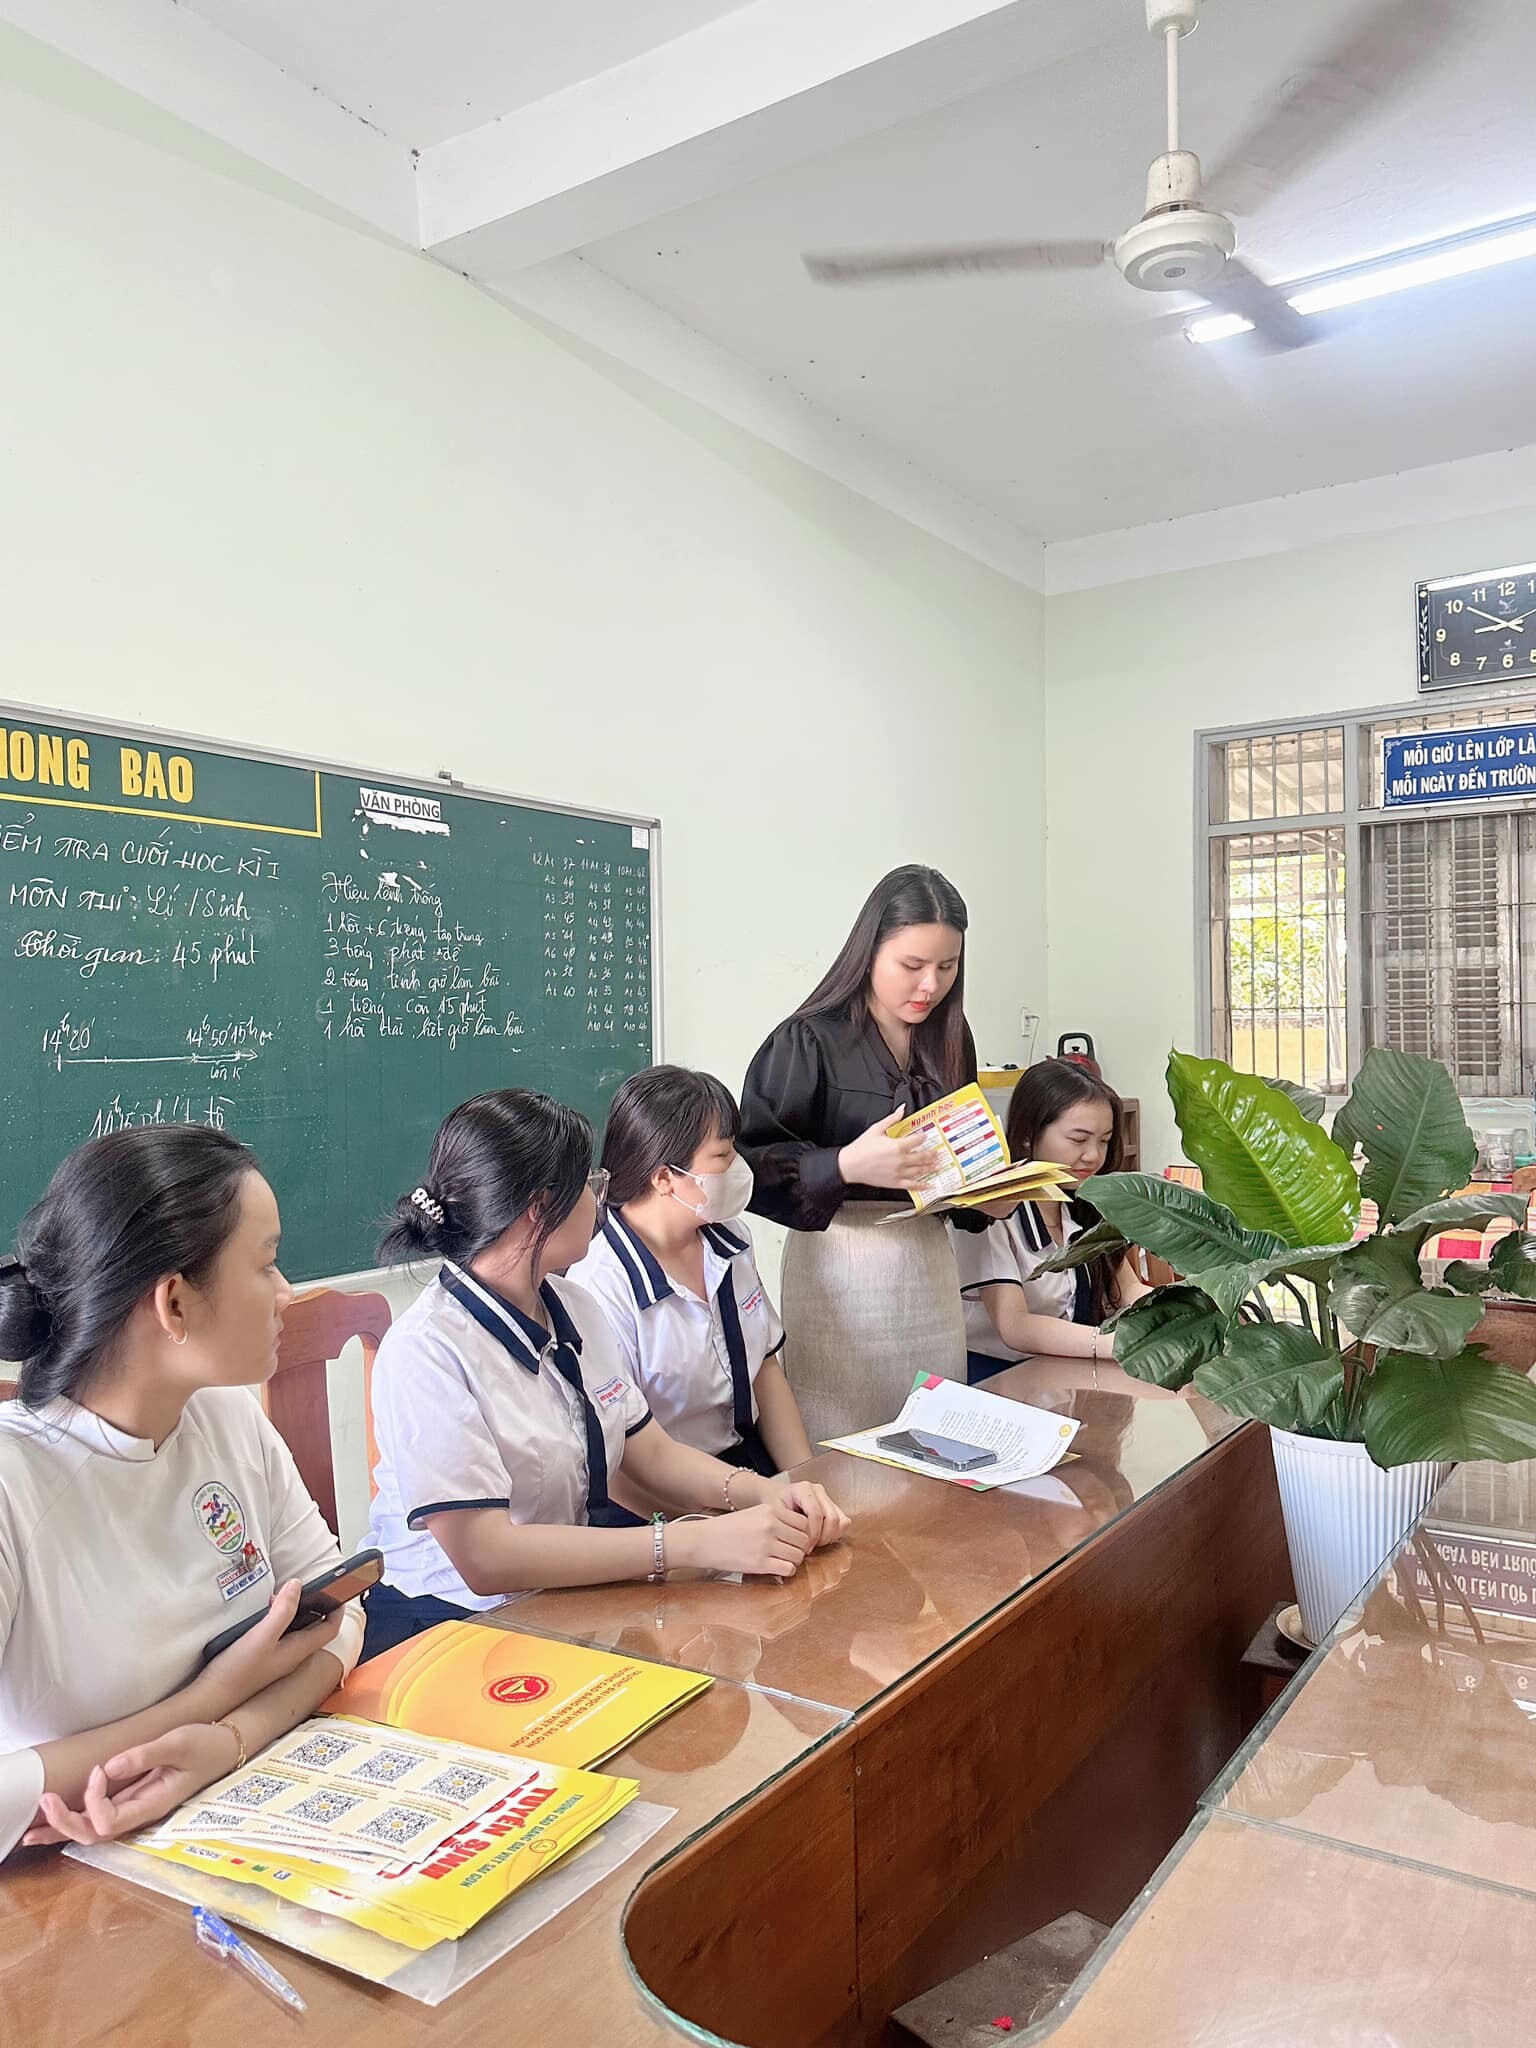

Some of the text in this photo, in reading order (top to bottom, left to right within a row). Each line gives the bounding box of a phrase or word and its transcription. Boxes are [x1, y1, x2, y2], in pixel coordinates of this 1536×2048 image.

[1445, 600, 1463, 614] 10
[1472, 588, 1486, 602] 11
[1497, 581, 1516, 596] 12
[1436, 628, 1446, 642] 9
[1450, 652, 1460, 666] 8
[1476, 656, 1487, 670] 7
[1503, 654, 1513, 668] 6
[0, 727, 194, 804] ONG BAO
[1403, 732, 1536, 767] MỖI GIỜ LÊN LỚP LÀ
[1392, 771, 1416, 797] MỖI
[1421, 771, 1455, 794] NGÀY
[1459, 765, 1486, 790] ĐẾN
[361, 790, 440, 818] VĂN PHÒNG
[0, 812, 42, 854] ỂM
[53, 836, 109, 862] TRA
[9, 877, 69, 909] MÔN
[202, 887, 251, 921] Sinh
[322, 872, 370, 903] Hiệu
[409, 883, 443, 918] trống
[323, 913, 334, 932] 1
[171, 940, 201, 969] 45
[210, 928, 260, 983] phút
[324, 938, 340, 956] 3
[341, 937, 372, 970] tiếng
[322, 967, 337, 986] 2
[320, 998, 336, 1014] 1
[323, 1020, 333, 1040] 1
[482, 1787, 559, 1838] TUYỂN
[419, 1838, 491, 1880] SINH
